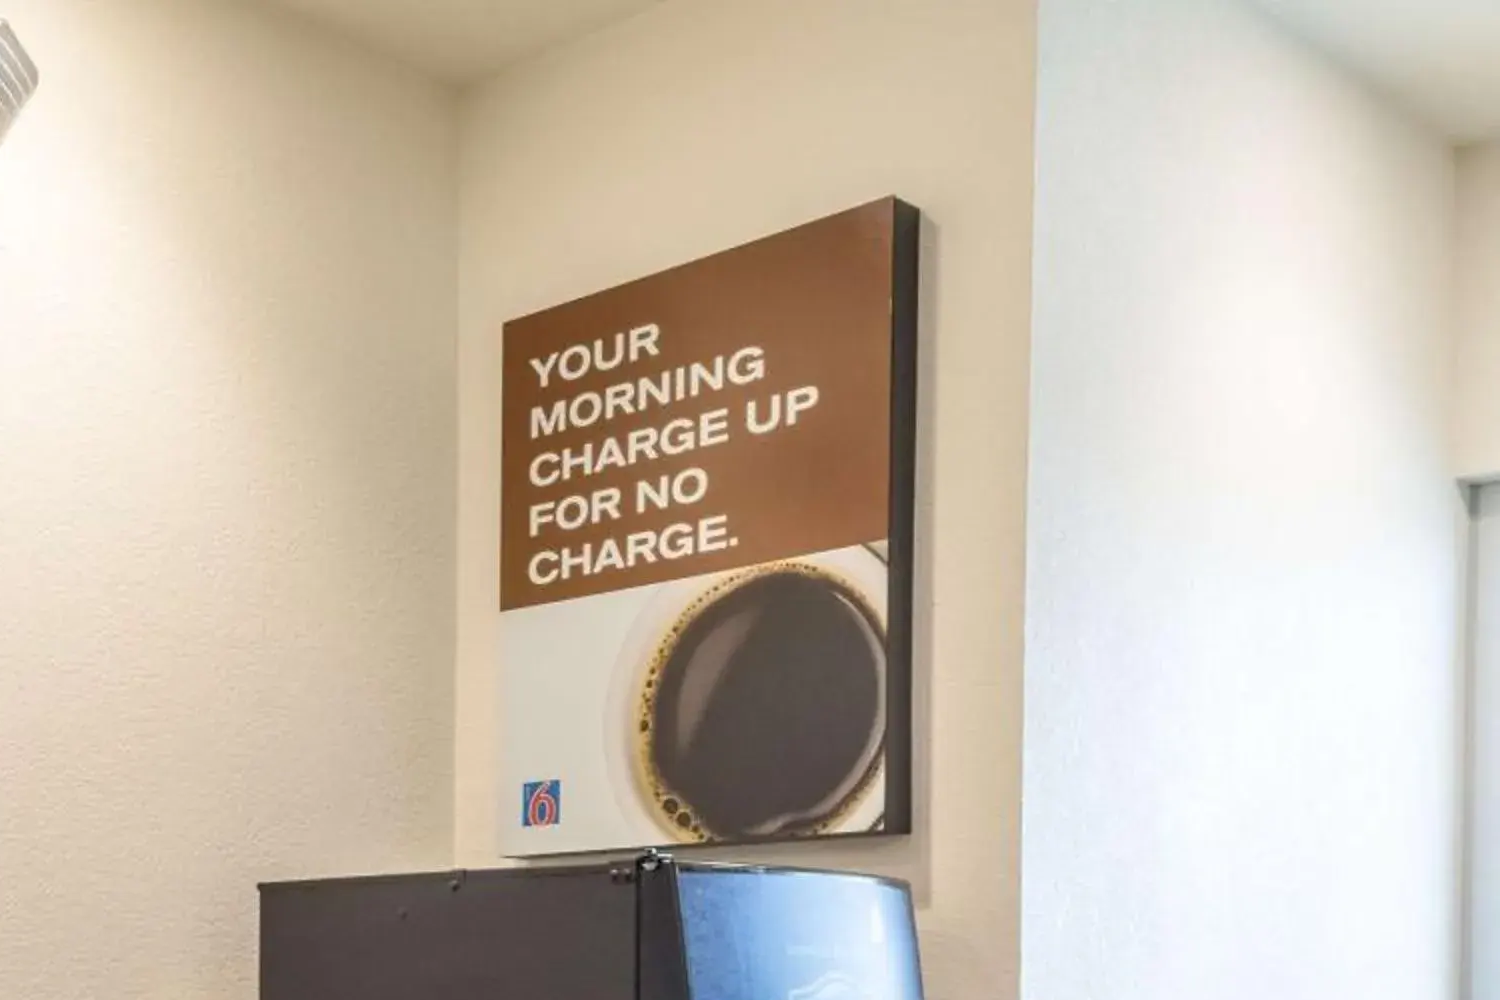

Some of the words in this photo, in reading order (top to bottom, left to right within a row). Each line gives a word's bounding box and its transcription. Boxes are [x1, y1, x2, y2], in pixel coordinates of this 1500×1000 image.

[529, 323, 660, 388] YOUR
[530, 346, 765, 439] MORNING
[529, 408, 729, 487] CHARGE
[746, 385, 819, 434] UP
[529, 488, 621, 537] FOR
[636, 467, 708, 514] NO
[527, 514, 739, 585] CHARGE.
[529, 783, 557, 829] 6
